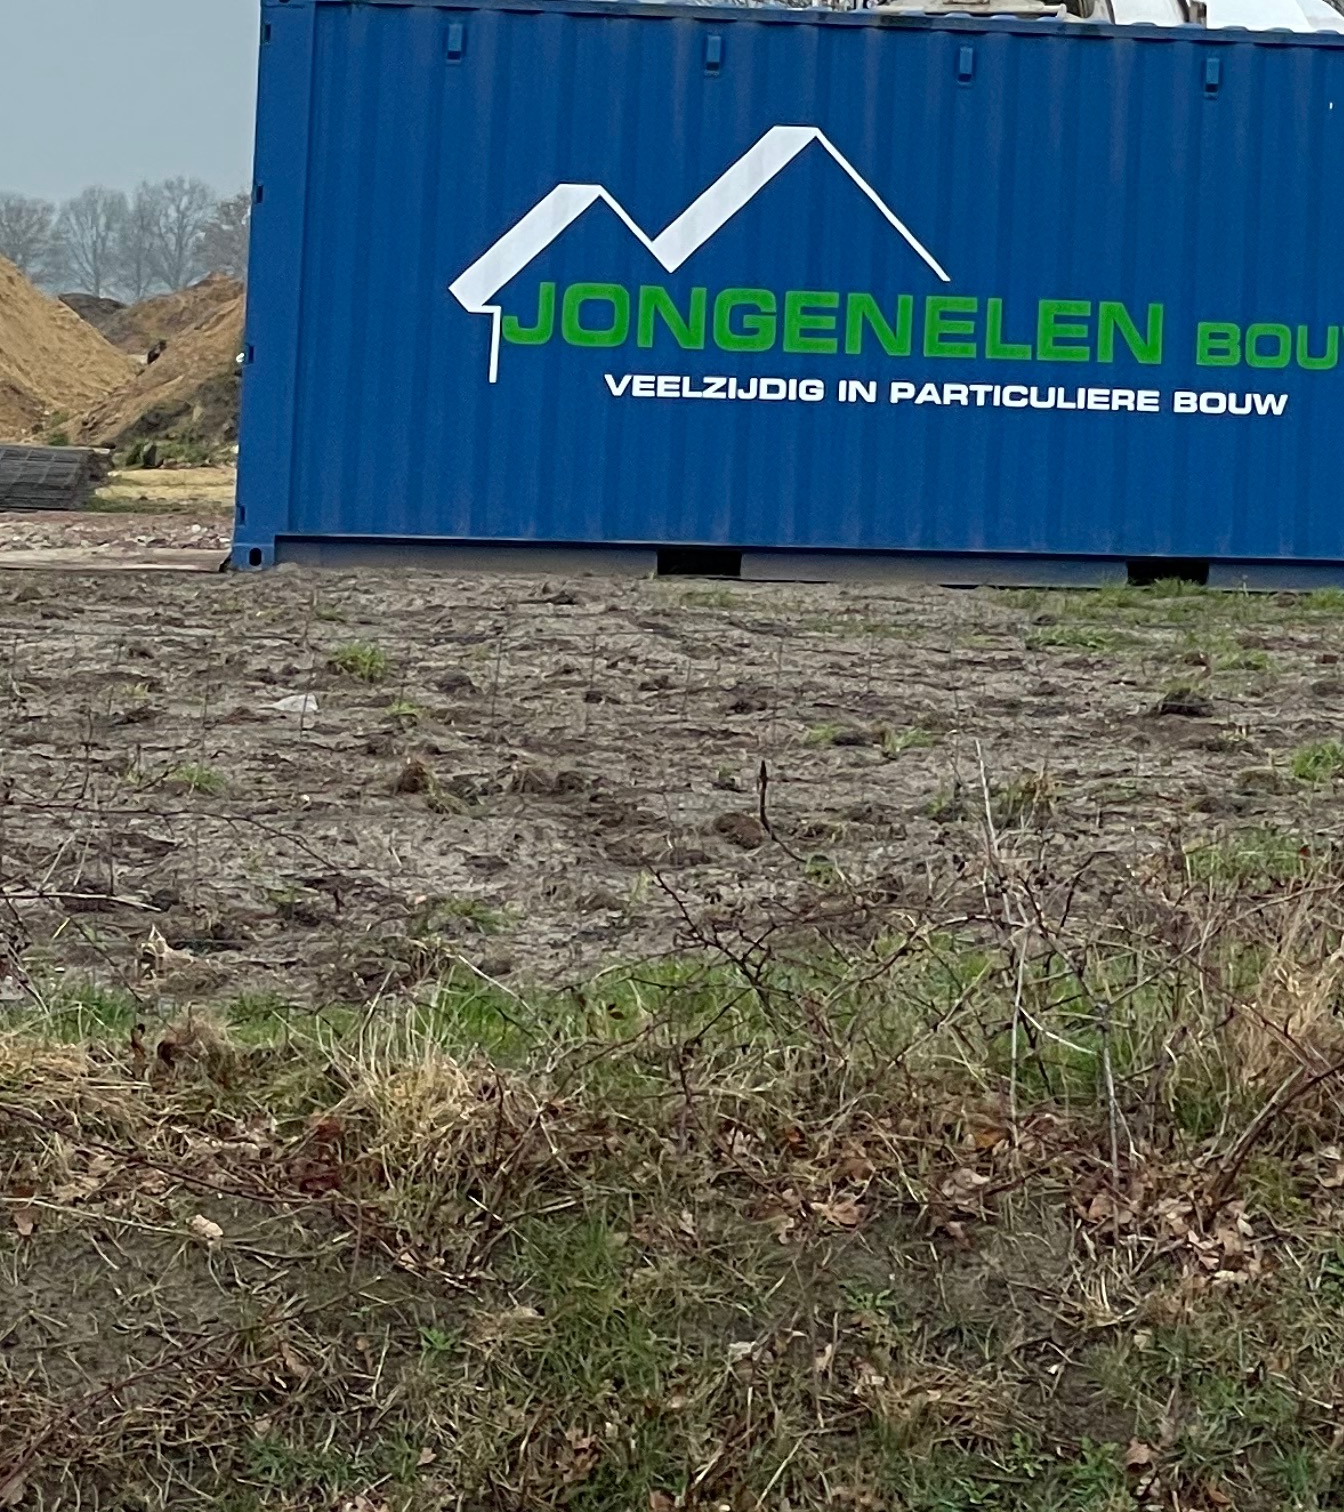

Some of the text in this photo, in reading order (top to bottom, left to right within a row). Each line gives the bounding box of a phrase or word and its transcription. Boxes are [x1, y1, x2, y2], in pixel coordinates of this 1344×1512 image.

[502, 281, 1165, 365] JONGENELEN
[603, 374, 1289, 416] VEELZIJDIG IN PARTICULIERE BOUW
